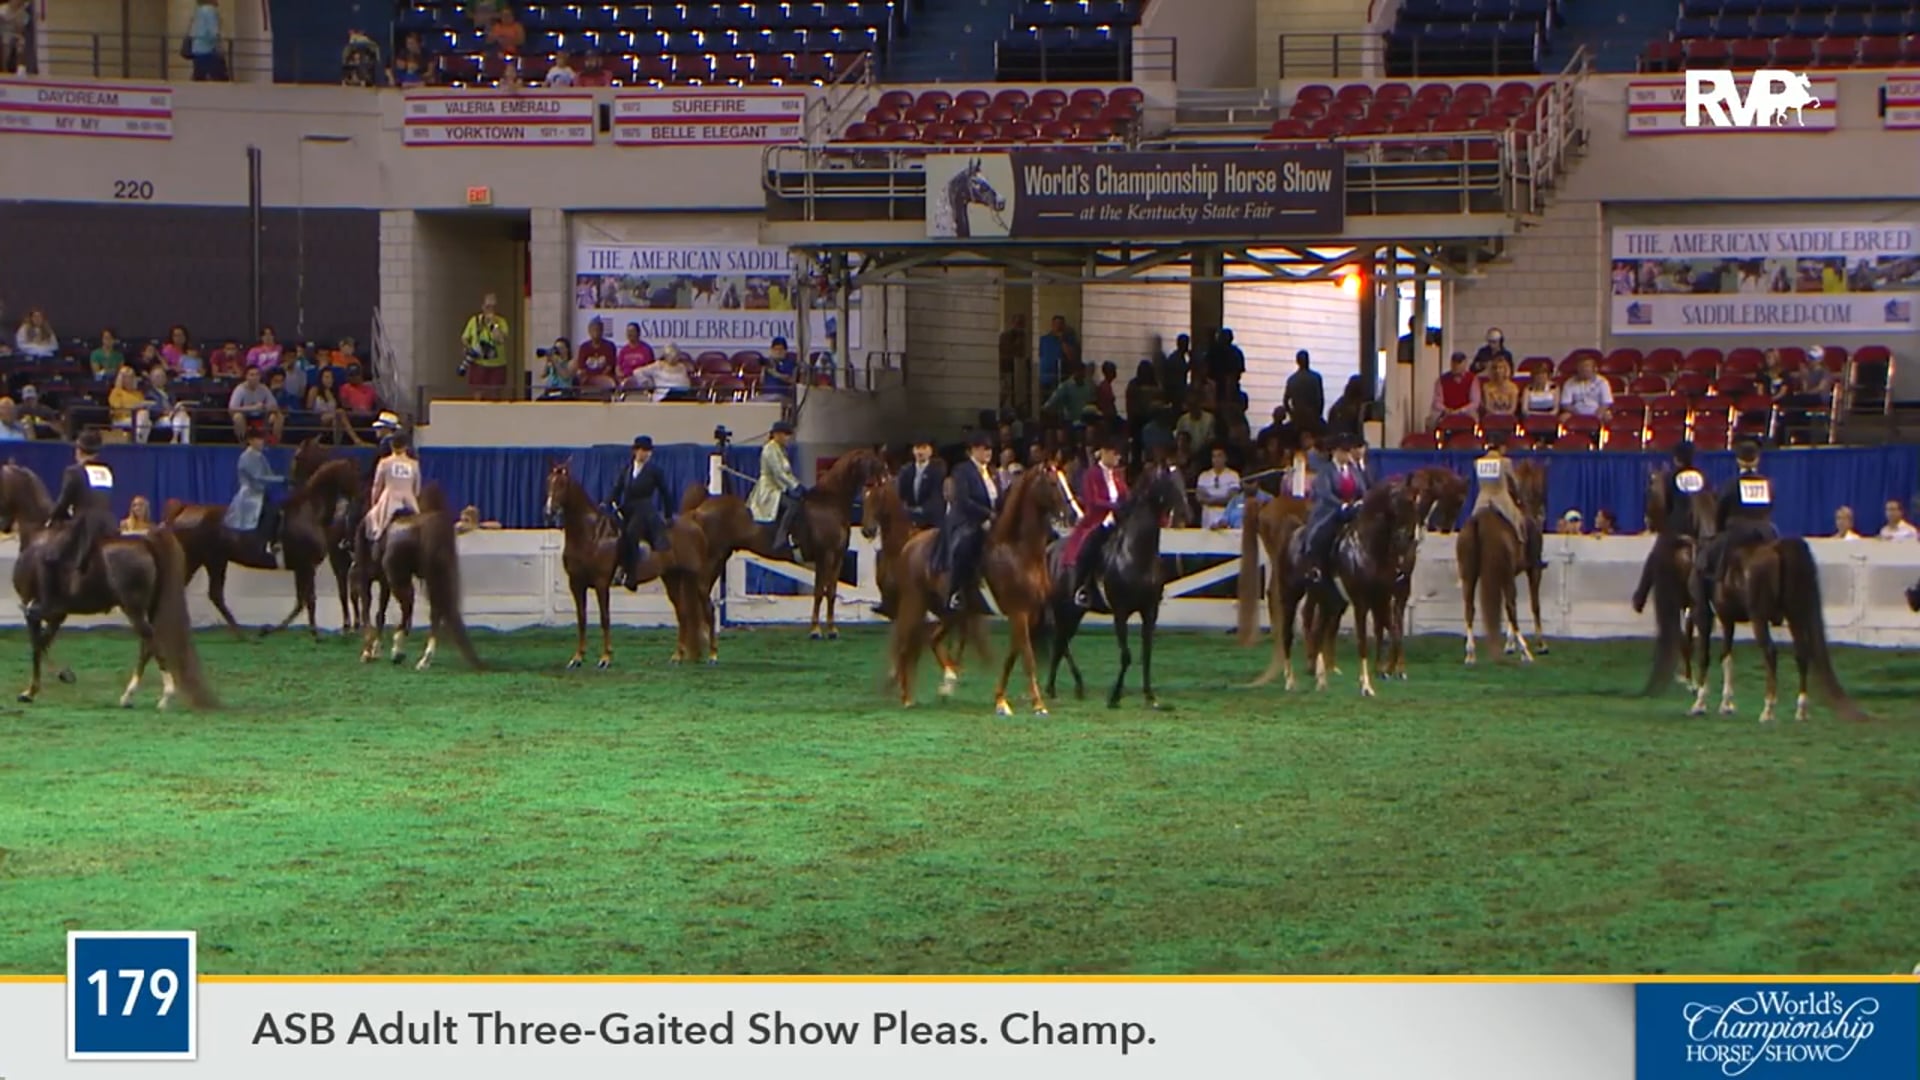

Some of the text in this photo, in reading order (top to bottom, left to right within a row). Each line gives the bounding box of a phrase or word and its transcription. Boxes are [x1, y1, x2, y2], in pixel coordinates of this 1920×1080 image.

[38, 89, 120, 106] DAYDREAM
[672, 99, 746, 113] SUREFIRE
[445, 101, 561, 114] VALERIA EMERALD
[55, 117, 100, 130] MY MY
[651, 126, 696, 139] BELLE
[703, 125, 768, 139] ELEGANT
[445, 127, 525, 140] YORKTOWN
[113, 179, 154, 200] 220
[1024, 161, 1333, 201] World's Championship Horse Show
[1079, 201, 1275, 224] at the Kentucky State Fair
[1625, 230, 1912, 254] THE AMERICAN SADDLEBRED
[589, 250, 624, 270] THE
[630, 250, 721, 271] AMERICAN
